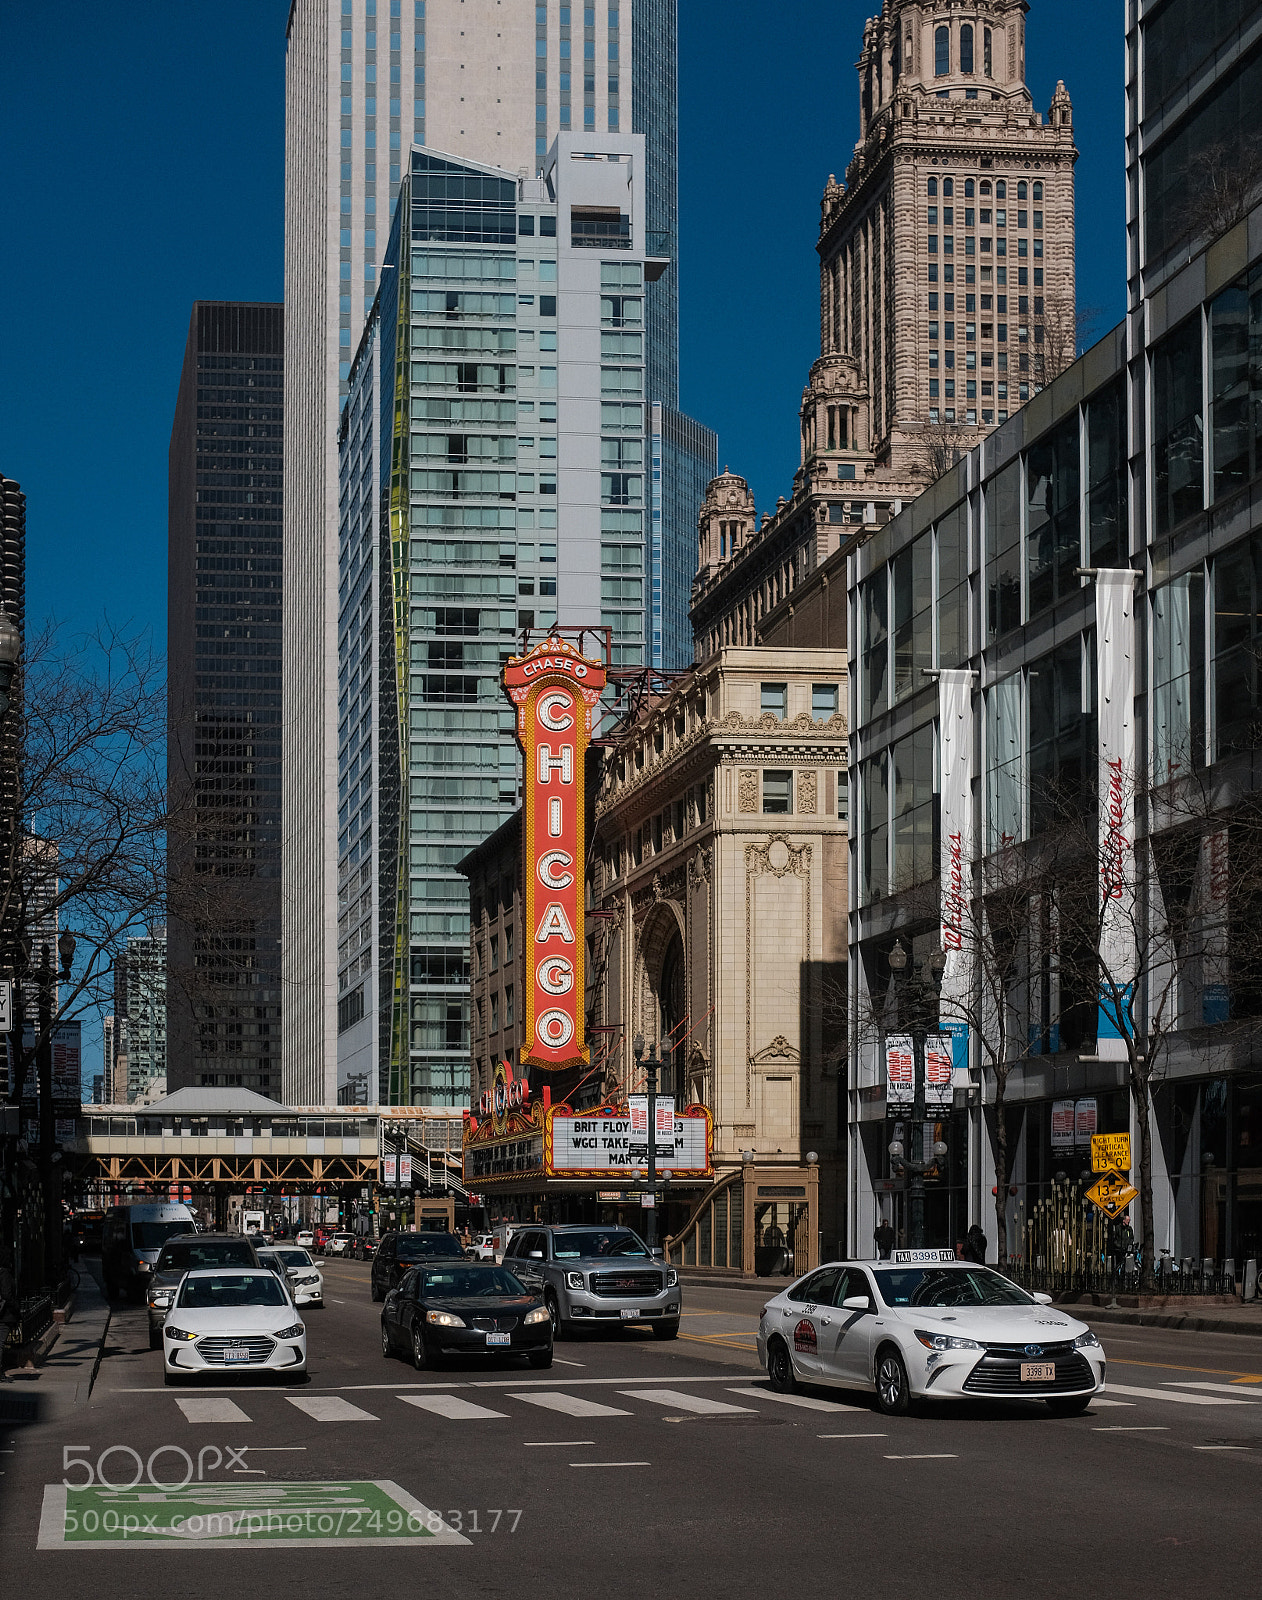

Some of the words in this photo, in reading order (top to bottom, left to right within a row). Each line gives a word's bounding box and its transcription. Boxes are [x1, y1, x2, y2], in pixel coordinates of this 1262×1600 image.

[523, 657, 574, 677] CHASE
[1102, 755, 1130, 899] Walgreens
[535, 691, 576, 1049] CHICAGO
[888, 1051, 901, 1082] WOMAN
[900, 1054, 913, 1083] PRETTY
[928, 1052, 940, 1083] WOMAN
[574, 1121, 598, 1133] BRIT
[603, 1121, 632, 1133] FLOY
[572, 1137, 598, 1149] WGCI
[1092, 1136, 1111, 1144] RIGHT
[1097, 1143, 1125, 1151] VERTICAL
[609, 1153, 633, 1165] MAR
[1094, 1150, 1129, 1158] CLEARANCE
[896, 1252, 910, 1262] TAXI
[912, 1251, 938, 1261] 3398
[939, 1251, 953, 1261] TAXI
[1026, 1367, 1042, 1377] 3398
[1045, 1367, 1054, 1376] TX
